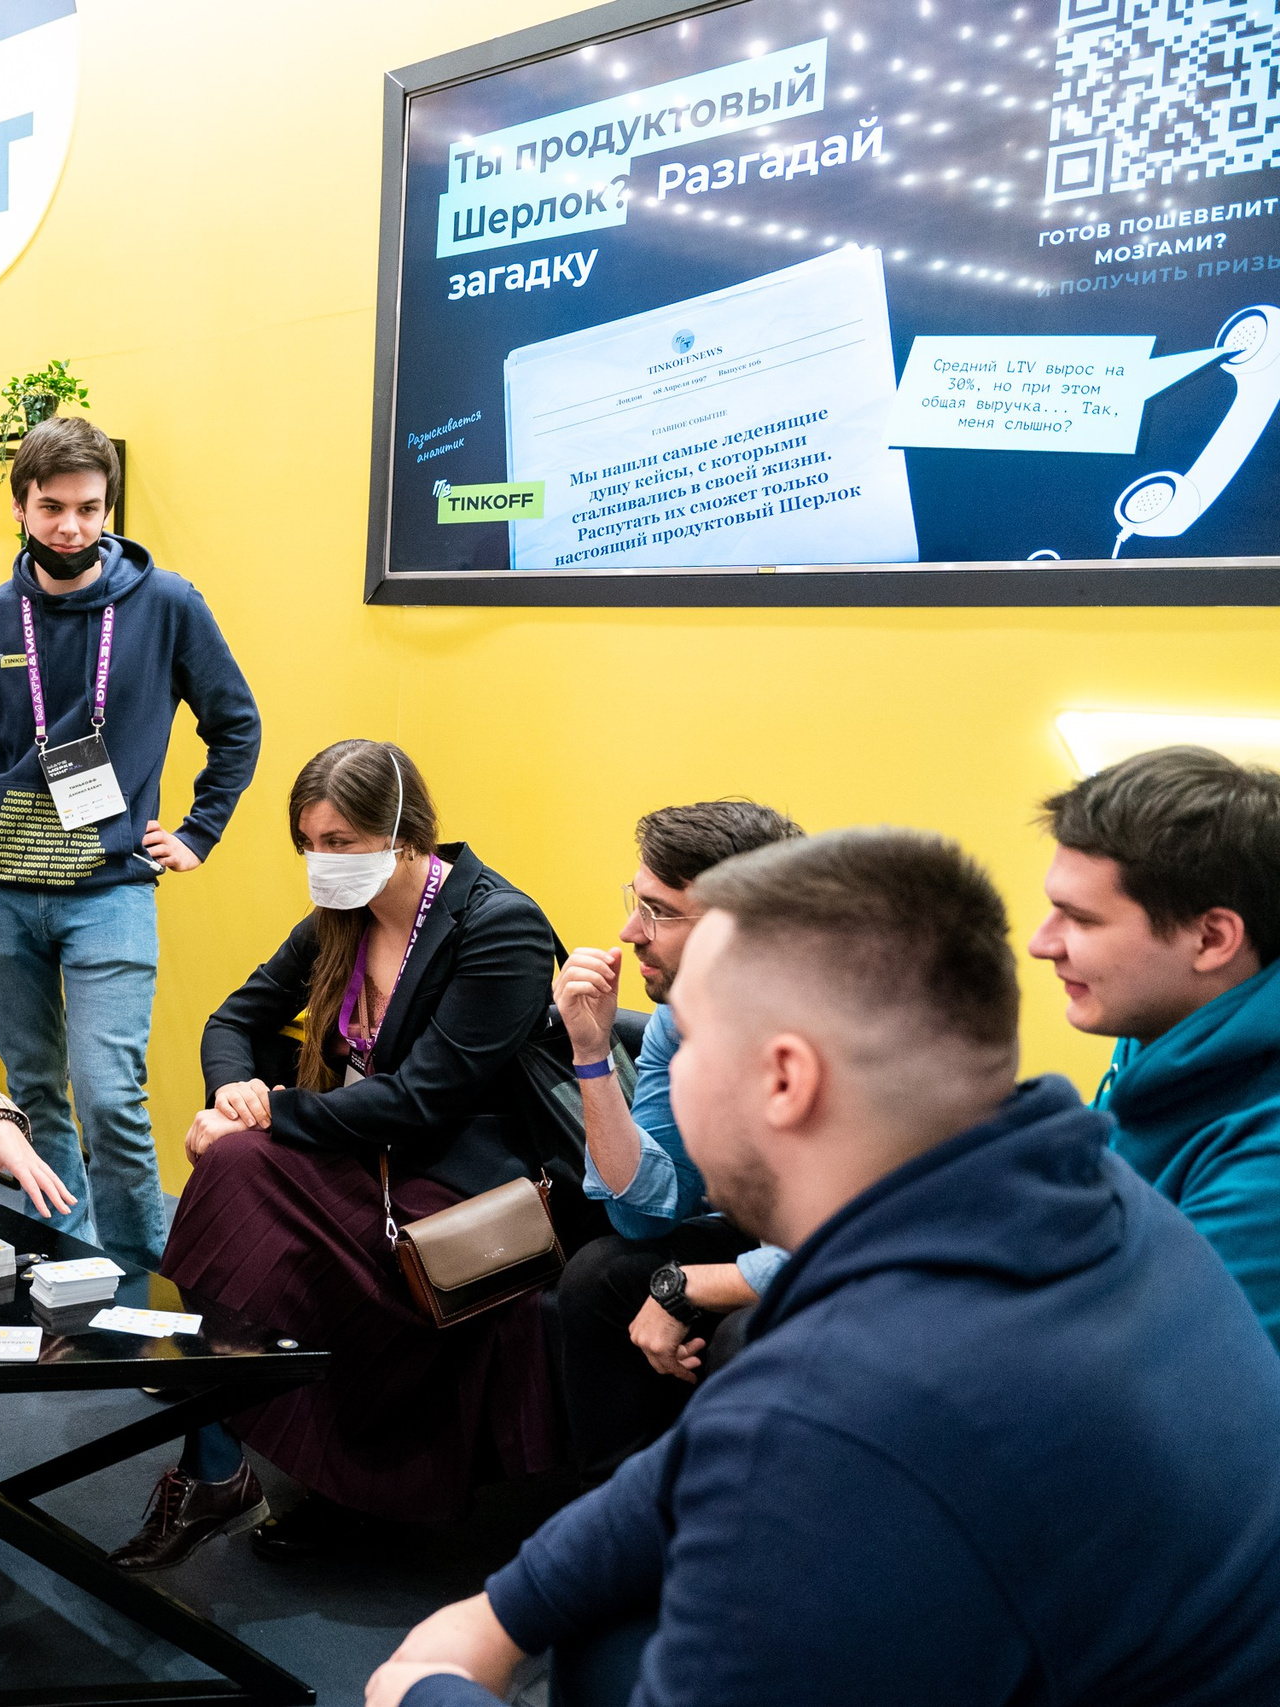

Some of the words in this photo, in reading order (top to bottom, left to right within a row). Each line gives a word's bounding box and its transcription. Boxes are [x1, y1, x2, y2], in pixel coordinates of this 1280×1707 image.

[455, 150, 501, 183] Ты
[516, 63, 815, 174] продуктовый
[453, 174, 631, 242] Шерлок?
[659, 116, 883, 200] Разгадай
[1039, 223, 1110, 247] ГОТОВ
[1095, 232, 1227, 265] МОЗГАМИ?
[447, 249, 599, 300] загадку
[1060, 266, 1188, 295] ПОЛУЧИТЬ
[647, 346, 723, 375] TINKOFFNEWS
[933, 358, 997, 373] Средний
[1007, 361, 1037, 373] LTV
[1045, 364, 1094, 379] вырос
[1105, 365, 1125, 377] на
[616, 395, 643, 406] Лондон
[663, 381, 690, 394] Апреля
[691, 376, 707, 386] 1997
[718, 364, 747, 377] Выпуск
[948, 377, 982, 393] 30%,
[993, 382, 1012, 392] но
[1022, 383, 1051, 396] при
[1061, 384, 1101, 395] этом
[651, 421, 688, 436] ГЛАВНОЕ
[688, 409, 728, 426] СОБЫТИЕ
[921, 396, 966, 410] общая
[976, 399, 1069, 414] выручка...
[1082, 401, 1119, 418] Так,
[407, 410, 482, 449] Разыскивается
[958, 417, 995, 429] меня
[1004, 419, 1073, 433] слышно?
[416, 437, 465, 463] аналитик
[569, 468, 598, 487] Мы
[602, 454, 658, 478] нашли
[662, 439, 718, 462] самые
[722, 409, 829, 446] леденящие
[589, 480, 631, 503] душу
[635, 464, 694, 489] кейсы,
[698, 460, 707, 472] с
[710, 435, 807, 470] которыми
[448, 493, 533, 511] TINKOFF
[571, 487, 687, 525] сталкивались
[691, 483, 701, 494] в
[705, 466, 757, 491] своей
[762, 451, 833, 476] жизни.
[577, 513, 661, 542] Распутать
[665, 506, 686, 521] их
[689, 488, 758, 515] сможет
[761, 472, 829, 497] только
[554, 535, 648, 567] настоящий
[651, 499, 774, 544] продуктовый
[779, 485, 862, 514] Шерлок
[4, 657, 28, 665] TINKO
